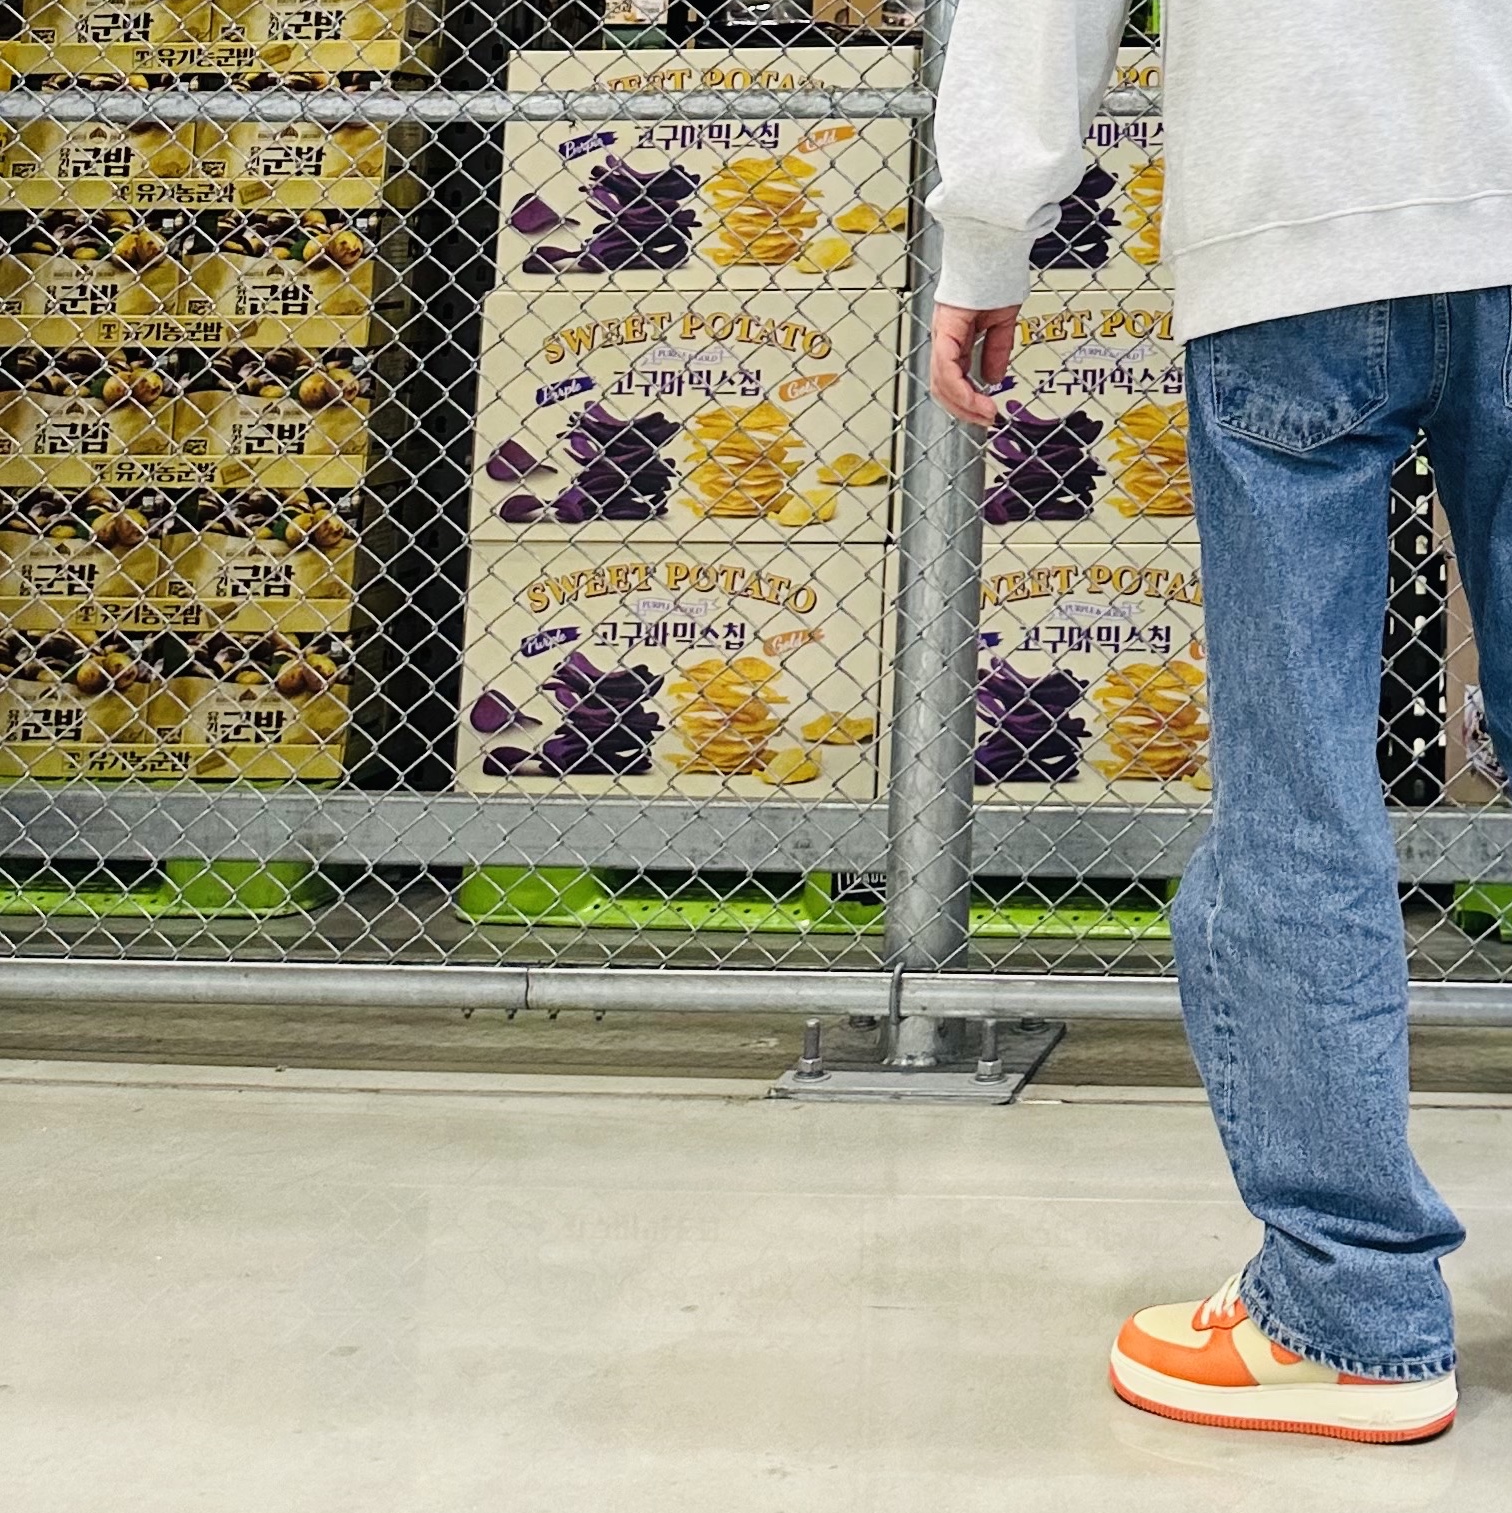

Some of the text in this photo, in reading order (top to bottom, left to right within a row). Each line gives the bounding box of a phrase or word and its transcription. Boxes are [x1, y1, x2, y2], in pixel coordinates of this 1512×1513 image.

[91, 12, 154, 41] 군밤
[282, 10, 346, 41] 군밤
[157, 47, 255, 68] 유기농군밤
[72, 146, 135, 178] 군밤
[263, 145, 327, 176] 군밤
[59, 284, 120, 315] 군밤
[249, 283, 314, 315] 군밤
[122, 322, 223, 342] 유기농군밤
[542, 310, 833, 365] SWEET POTATO
[47, 422, 111, 455] 군밤
[244, 422, 308, 455] 군밤
[33, 563, 100, 597] 군밤
[229, 563, 296, 598] 군밤
[526, 561, 817, 616] SWEET POTATO
[100, 603, 203, 626] 유기농군밤
[20, 708, 85, 742] 군밤
[219, 710, 288, 744] 군밤
[87, 750, 192, 773] 유기농군밤
